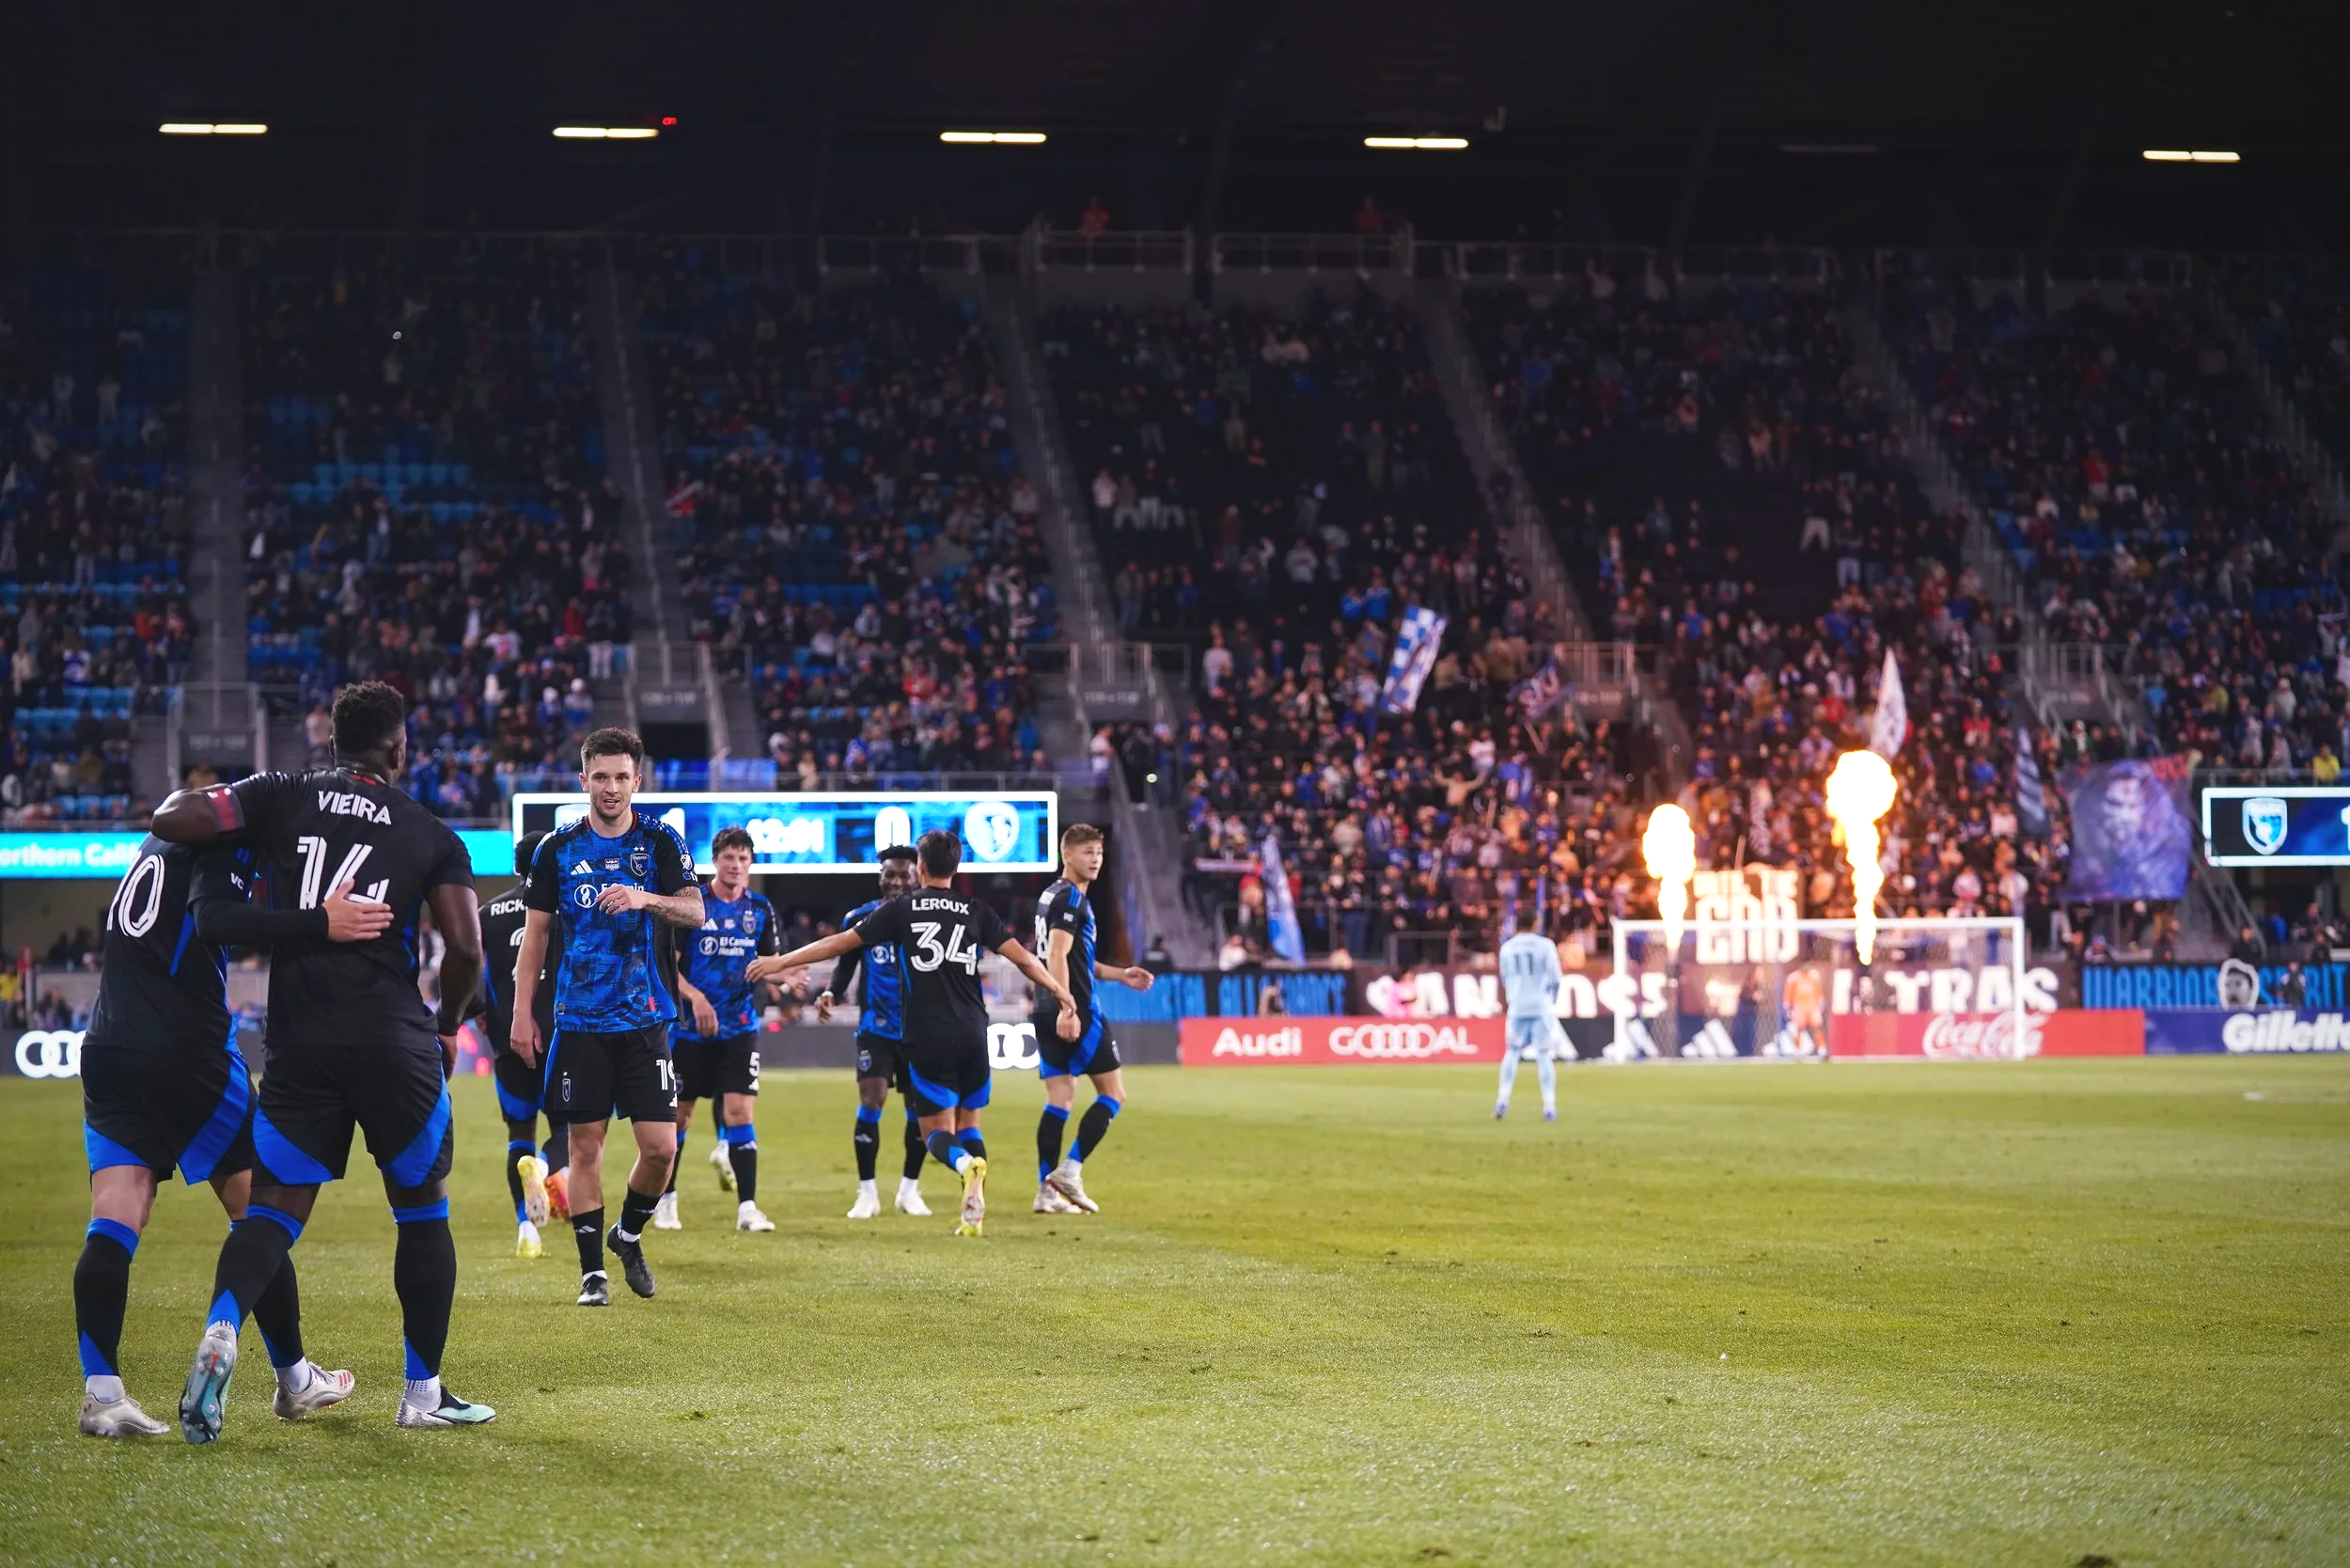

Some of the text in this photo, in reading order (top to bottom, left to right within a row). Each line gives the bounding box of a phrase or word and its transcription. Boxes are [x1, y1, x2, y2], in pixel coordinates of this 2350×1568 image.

[318, 790, 392, 825] VIEIRA
[875, 806, 911, 854] 0
[297, 836, 390, 910] 14
[911, 898, 970, 916] LEROUX
[910, 921, 978, 976] 34
[1512, 951, 1536, 976] 11
[1212, 1027, 1303, 1058] Audi
[748, 1051, 760, 1077] 5
